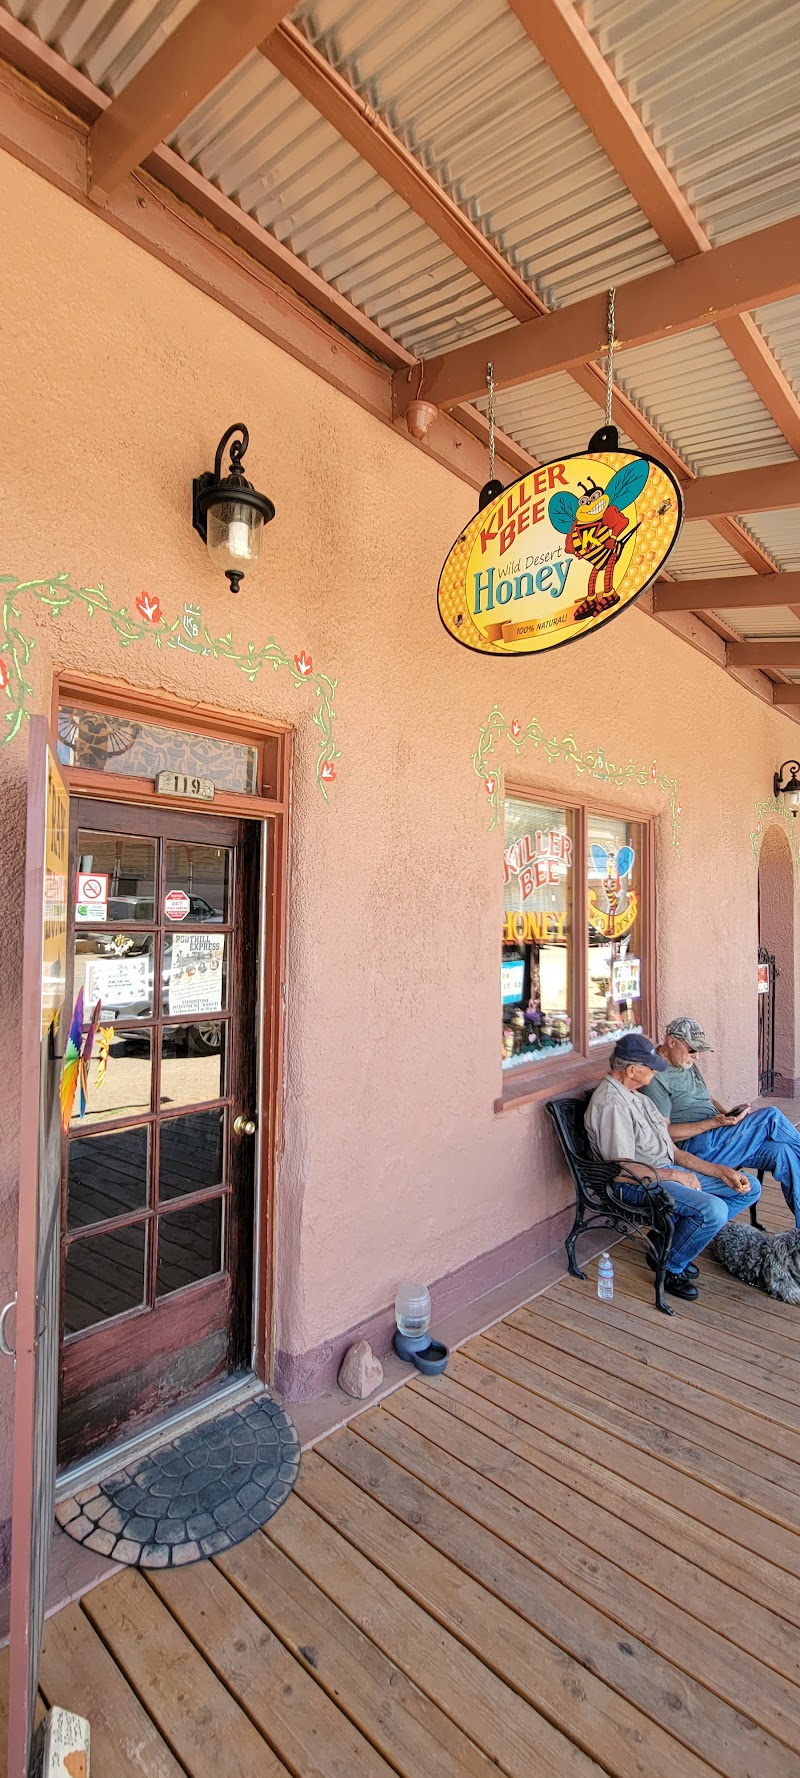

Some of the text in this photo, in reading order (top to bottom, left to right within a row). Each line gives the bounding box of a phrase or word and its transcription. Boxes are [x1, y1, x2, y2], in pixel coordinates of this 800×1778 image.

[479, 463, 570, 554] KILLER
[499, 497, 546, 557] BEE
[582, 528, 601, 549] K
[498, 545, 563, 579] Wild Desert
[473, 557, 573, 615] Honey
[516, 613, 568, 635] 100% NATURAL!
[174, 775, 200, 794] 119
[502, 831, 572, 885] KILLER
[519, 859, 561, 902] BEE
[502, 910, 568, 944] HONEY
[189, 942, 220, 951] EXPRESS
